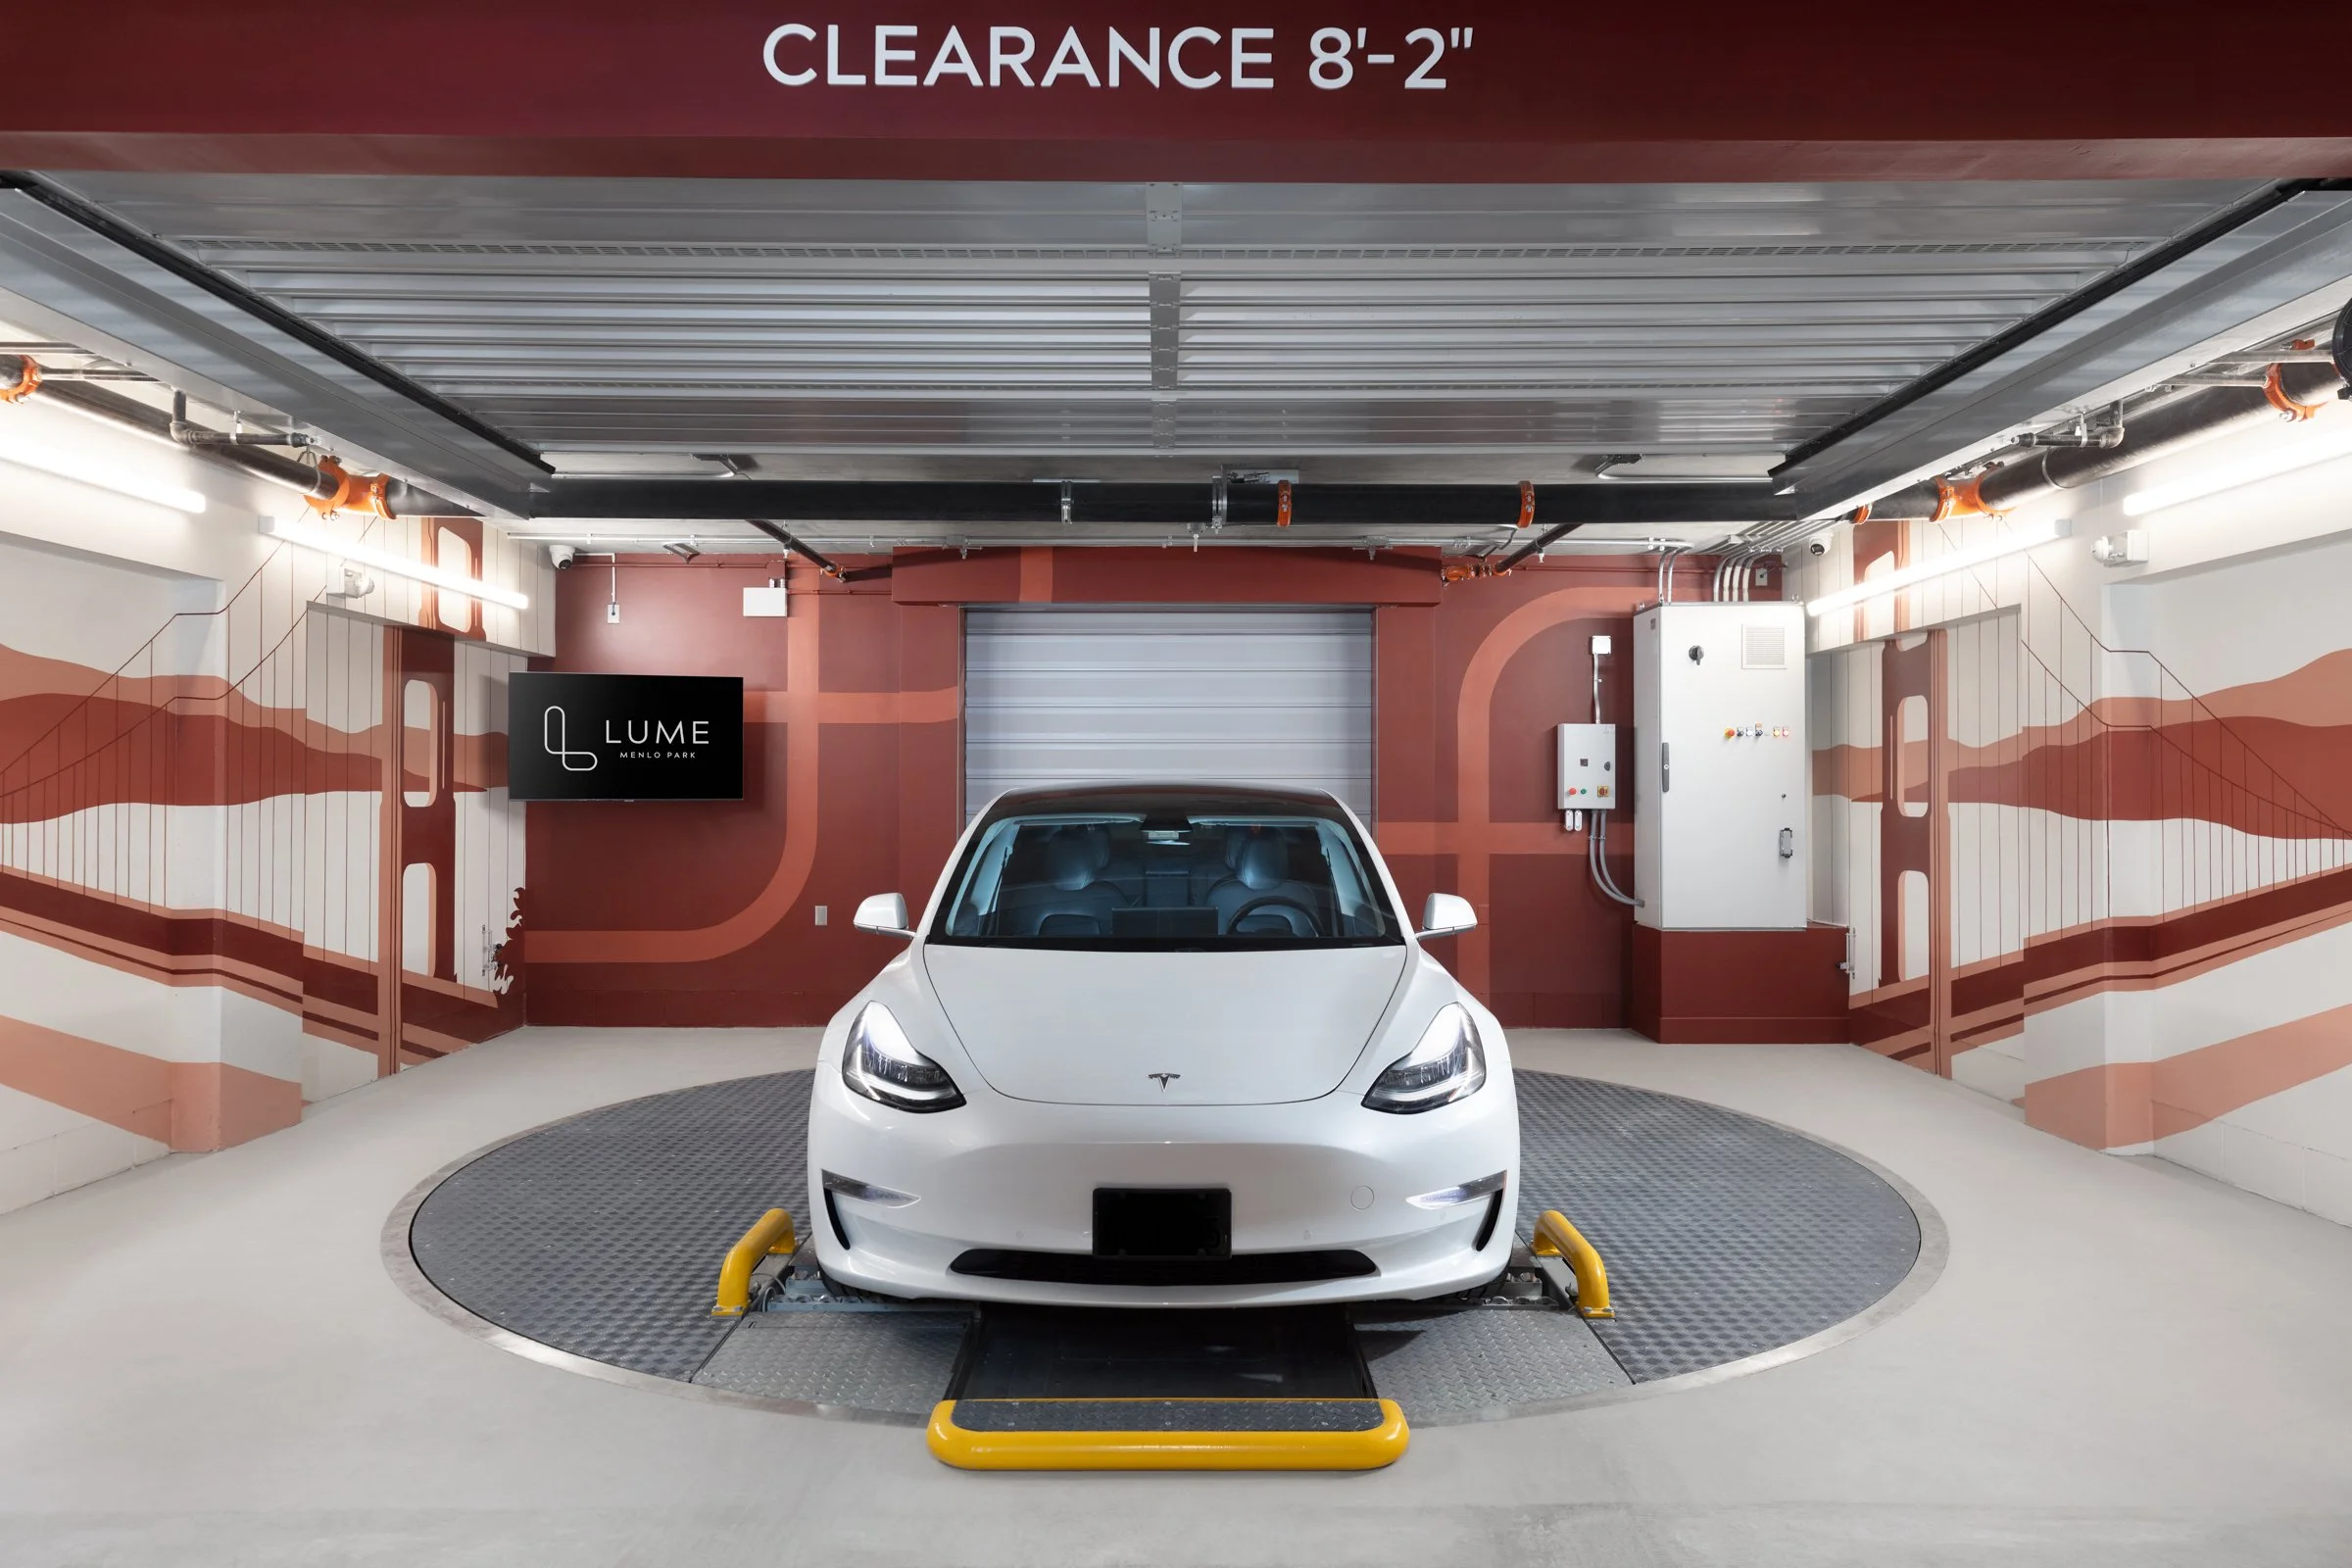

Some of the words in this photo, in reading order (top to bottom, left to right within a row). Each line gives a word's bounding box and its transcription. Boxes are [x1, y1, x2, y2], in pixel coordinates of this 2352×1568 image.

[761, 23, 1276, 90] CLEARANCE
[605, 719, 710, 745] LUME
[619, 751, 662, 760] MENLO
[666, 751, 696, 760] PARK
